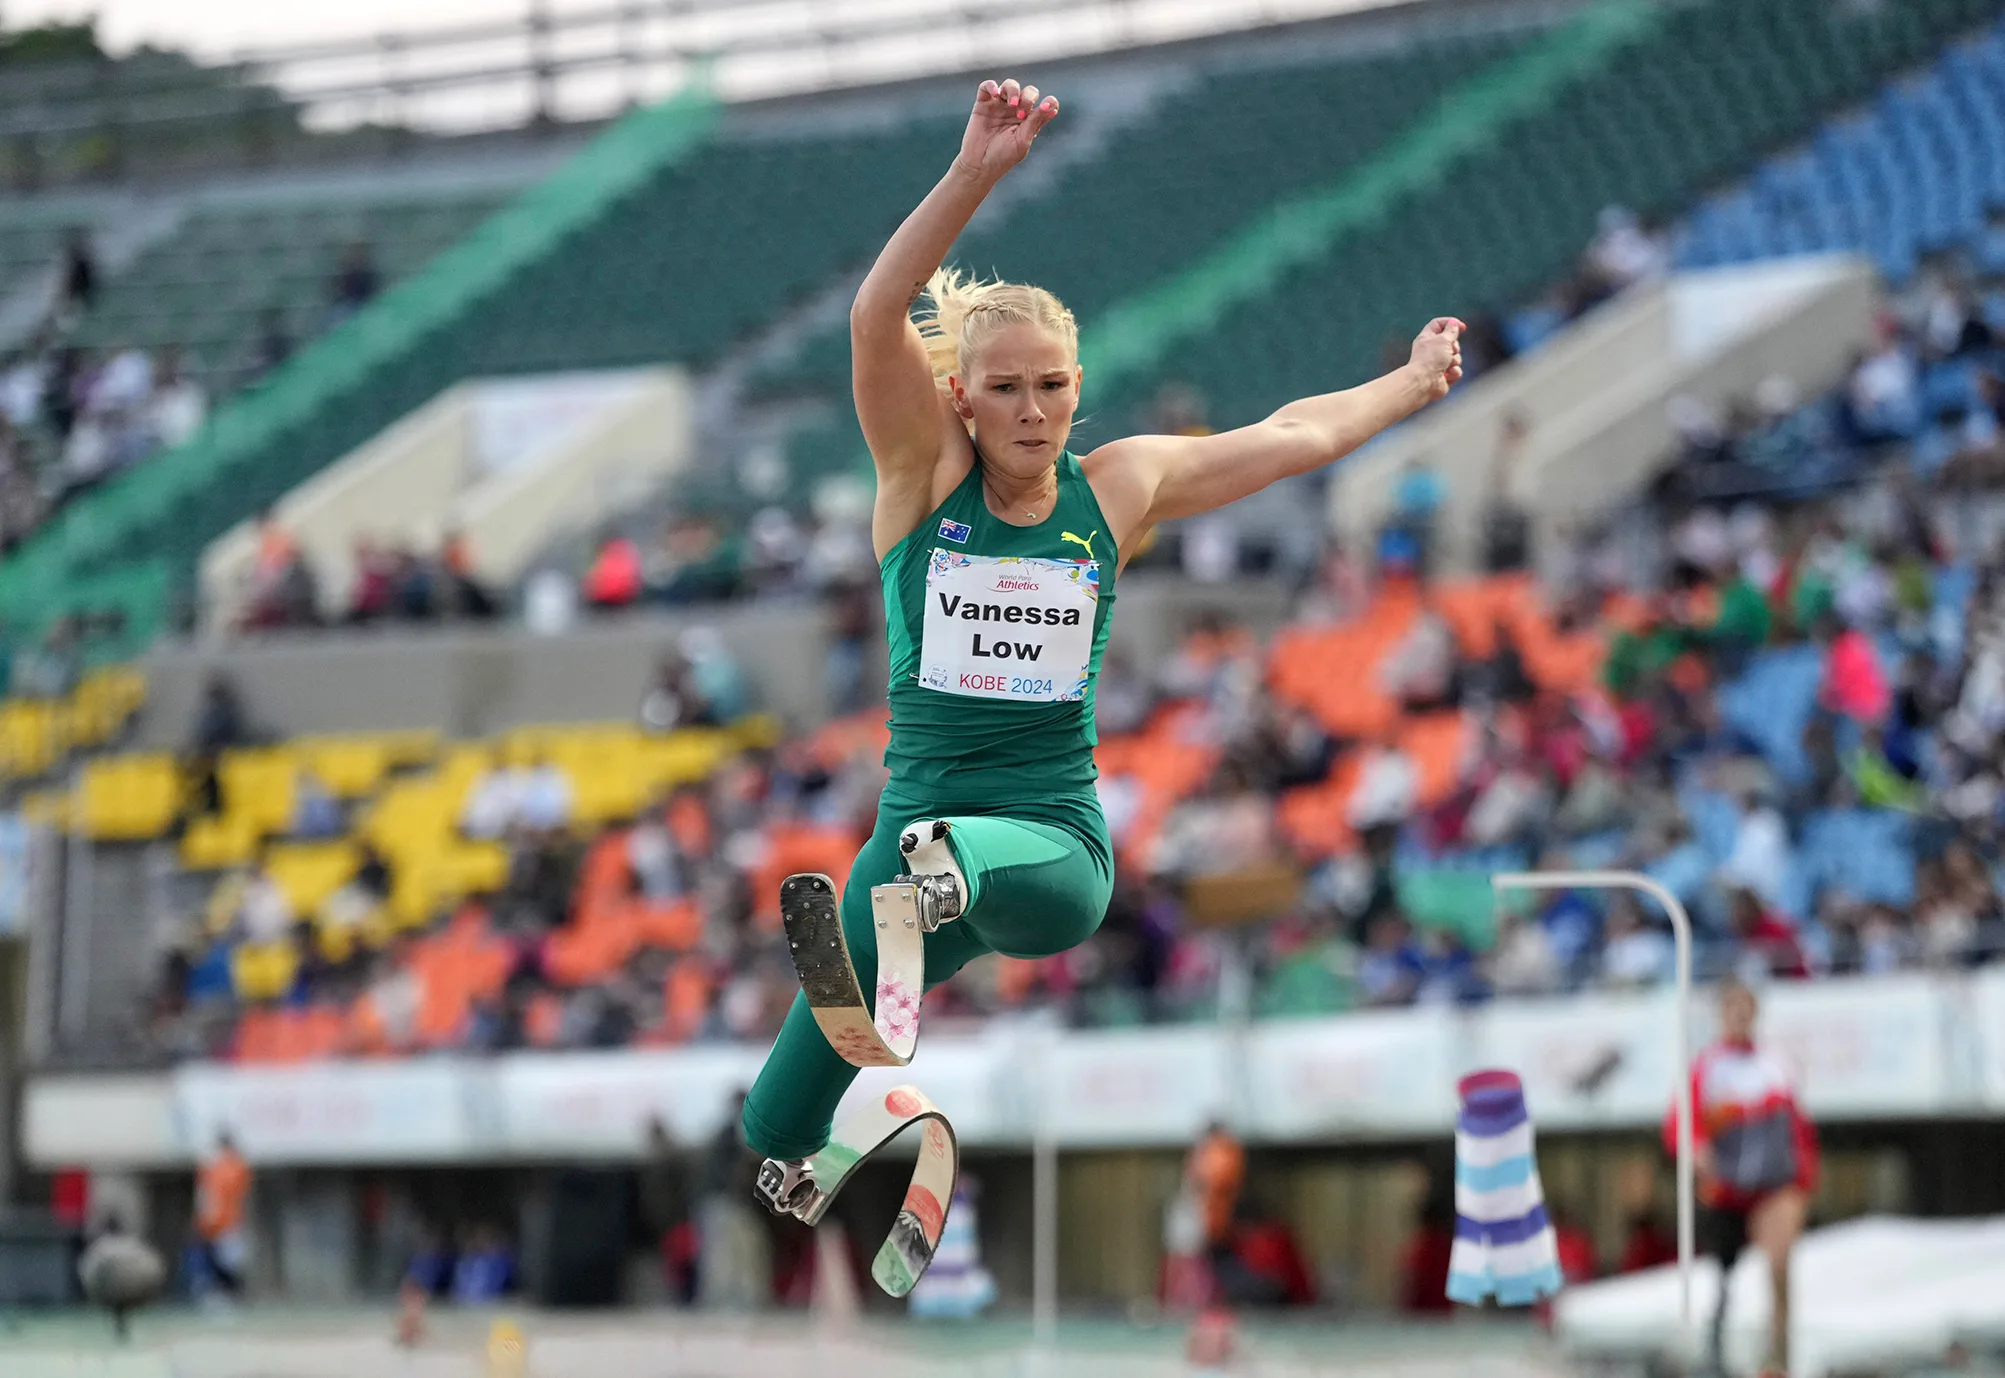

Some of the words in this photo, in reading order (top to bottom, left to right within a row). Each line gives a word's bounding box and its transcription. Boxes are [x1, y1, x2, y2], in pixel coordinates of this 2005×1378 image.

[996, 580, 1039, 591] Athletics
[939, 592, 1080, 626] Vanessa
[971, 633, 1043, 662] Low
[959, 673, 1007, 691] KOBE
[1011, 677, 1053, 694] 2024
